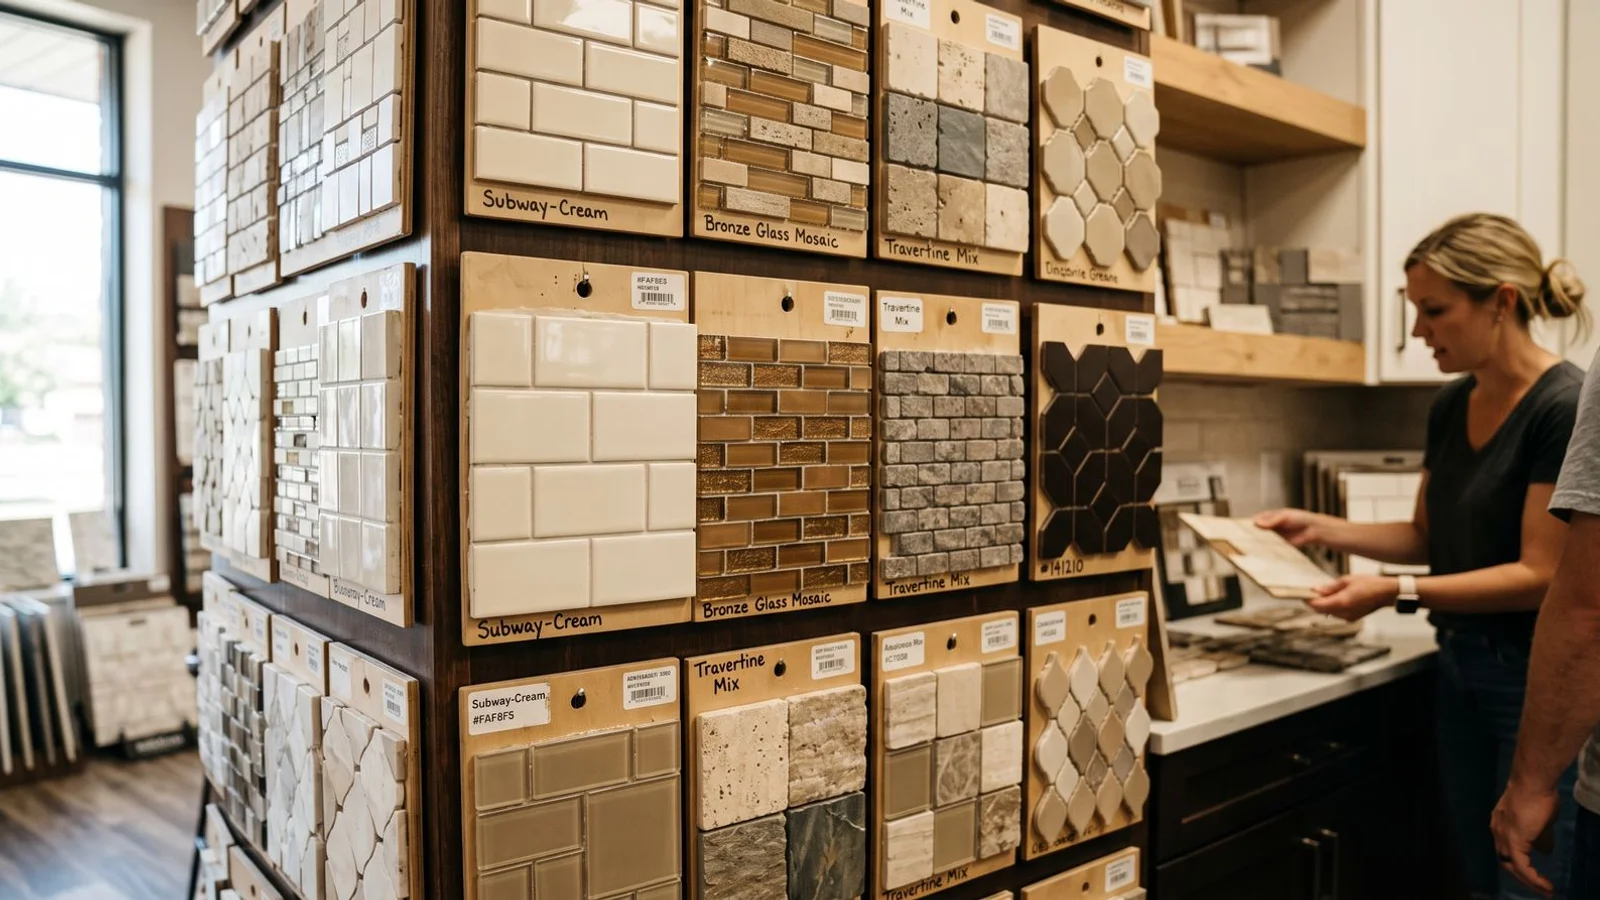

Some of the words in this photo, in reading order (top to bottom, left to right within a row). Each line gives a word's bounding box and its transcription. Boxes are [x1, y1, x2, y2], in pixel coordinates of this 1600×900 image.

[482, 189, 609, 221] Subway-Cream
[705, 214, 751, 236] Bronze
[756, 222, 789, 242] Glass
[795, 228, 839, 248] Mosaic
[886, 239, 950, 262] Travertine
[957, 249, 978, 265] Mix
[883, 302, 920, 314] Travertine
[895, 316, 909, 326] Mix
[1040, 560, 1084, 575] #141210
[885, 575, 946, 596] Travertine
[950, 573, 970, 587] Mix
[703, 602, 748, 618] Bronze
[755, 596, 787, 612] Glass
[792, 591, 832, 608] Mosaic
[477, 613, 603, 640] Subway-Cream
[694, 654, 766, 679] Travertine
[714, 678, 741, 694] Mix
[472, 692, 546, 710] Subway-Cream
[882, 877, 943, 900] Travertine
[947, 866, 968, 883] Mix
